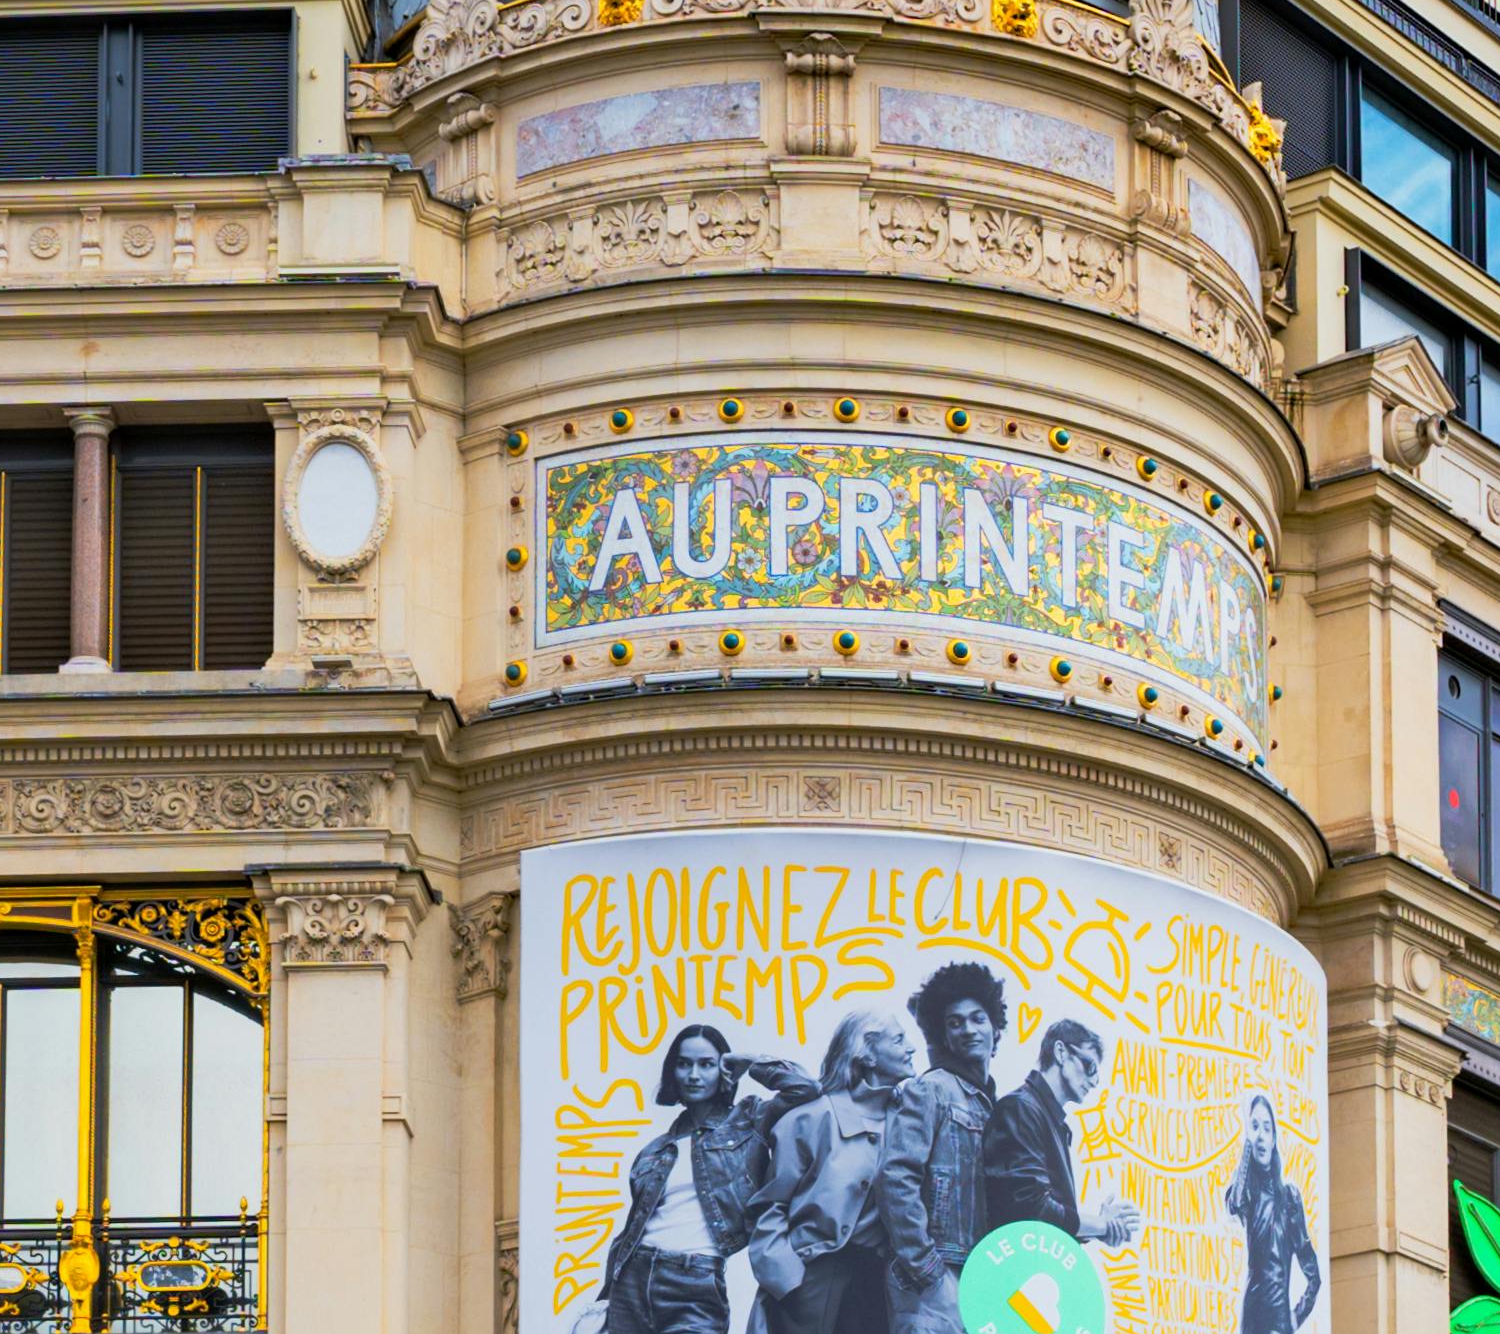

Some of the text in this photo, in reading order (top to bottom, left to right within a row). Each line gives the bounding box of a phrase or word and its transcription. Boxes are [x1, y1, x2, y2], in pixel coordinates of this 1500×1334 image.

[589, 477, 1260, 703] AU PRINTEMPS
[560, 864, 1055, 976] REJOIGNEZ LE CLUB
[559, 937, 896, 1079] PRINTEMPS
[1156, 981, 1224, 1040] POUR
[552, 1077, 653, 1317] PRINTEMPS
[985, 1231, 1078, 1271] LE CLUB
[1140, 1225, 1232, 1285] ATTENTIONS
